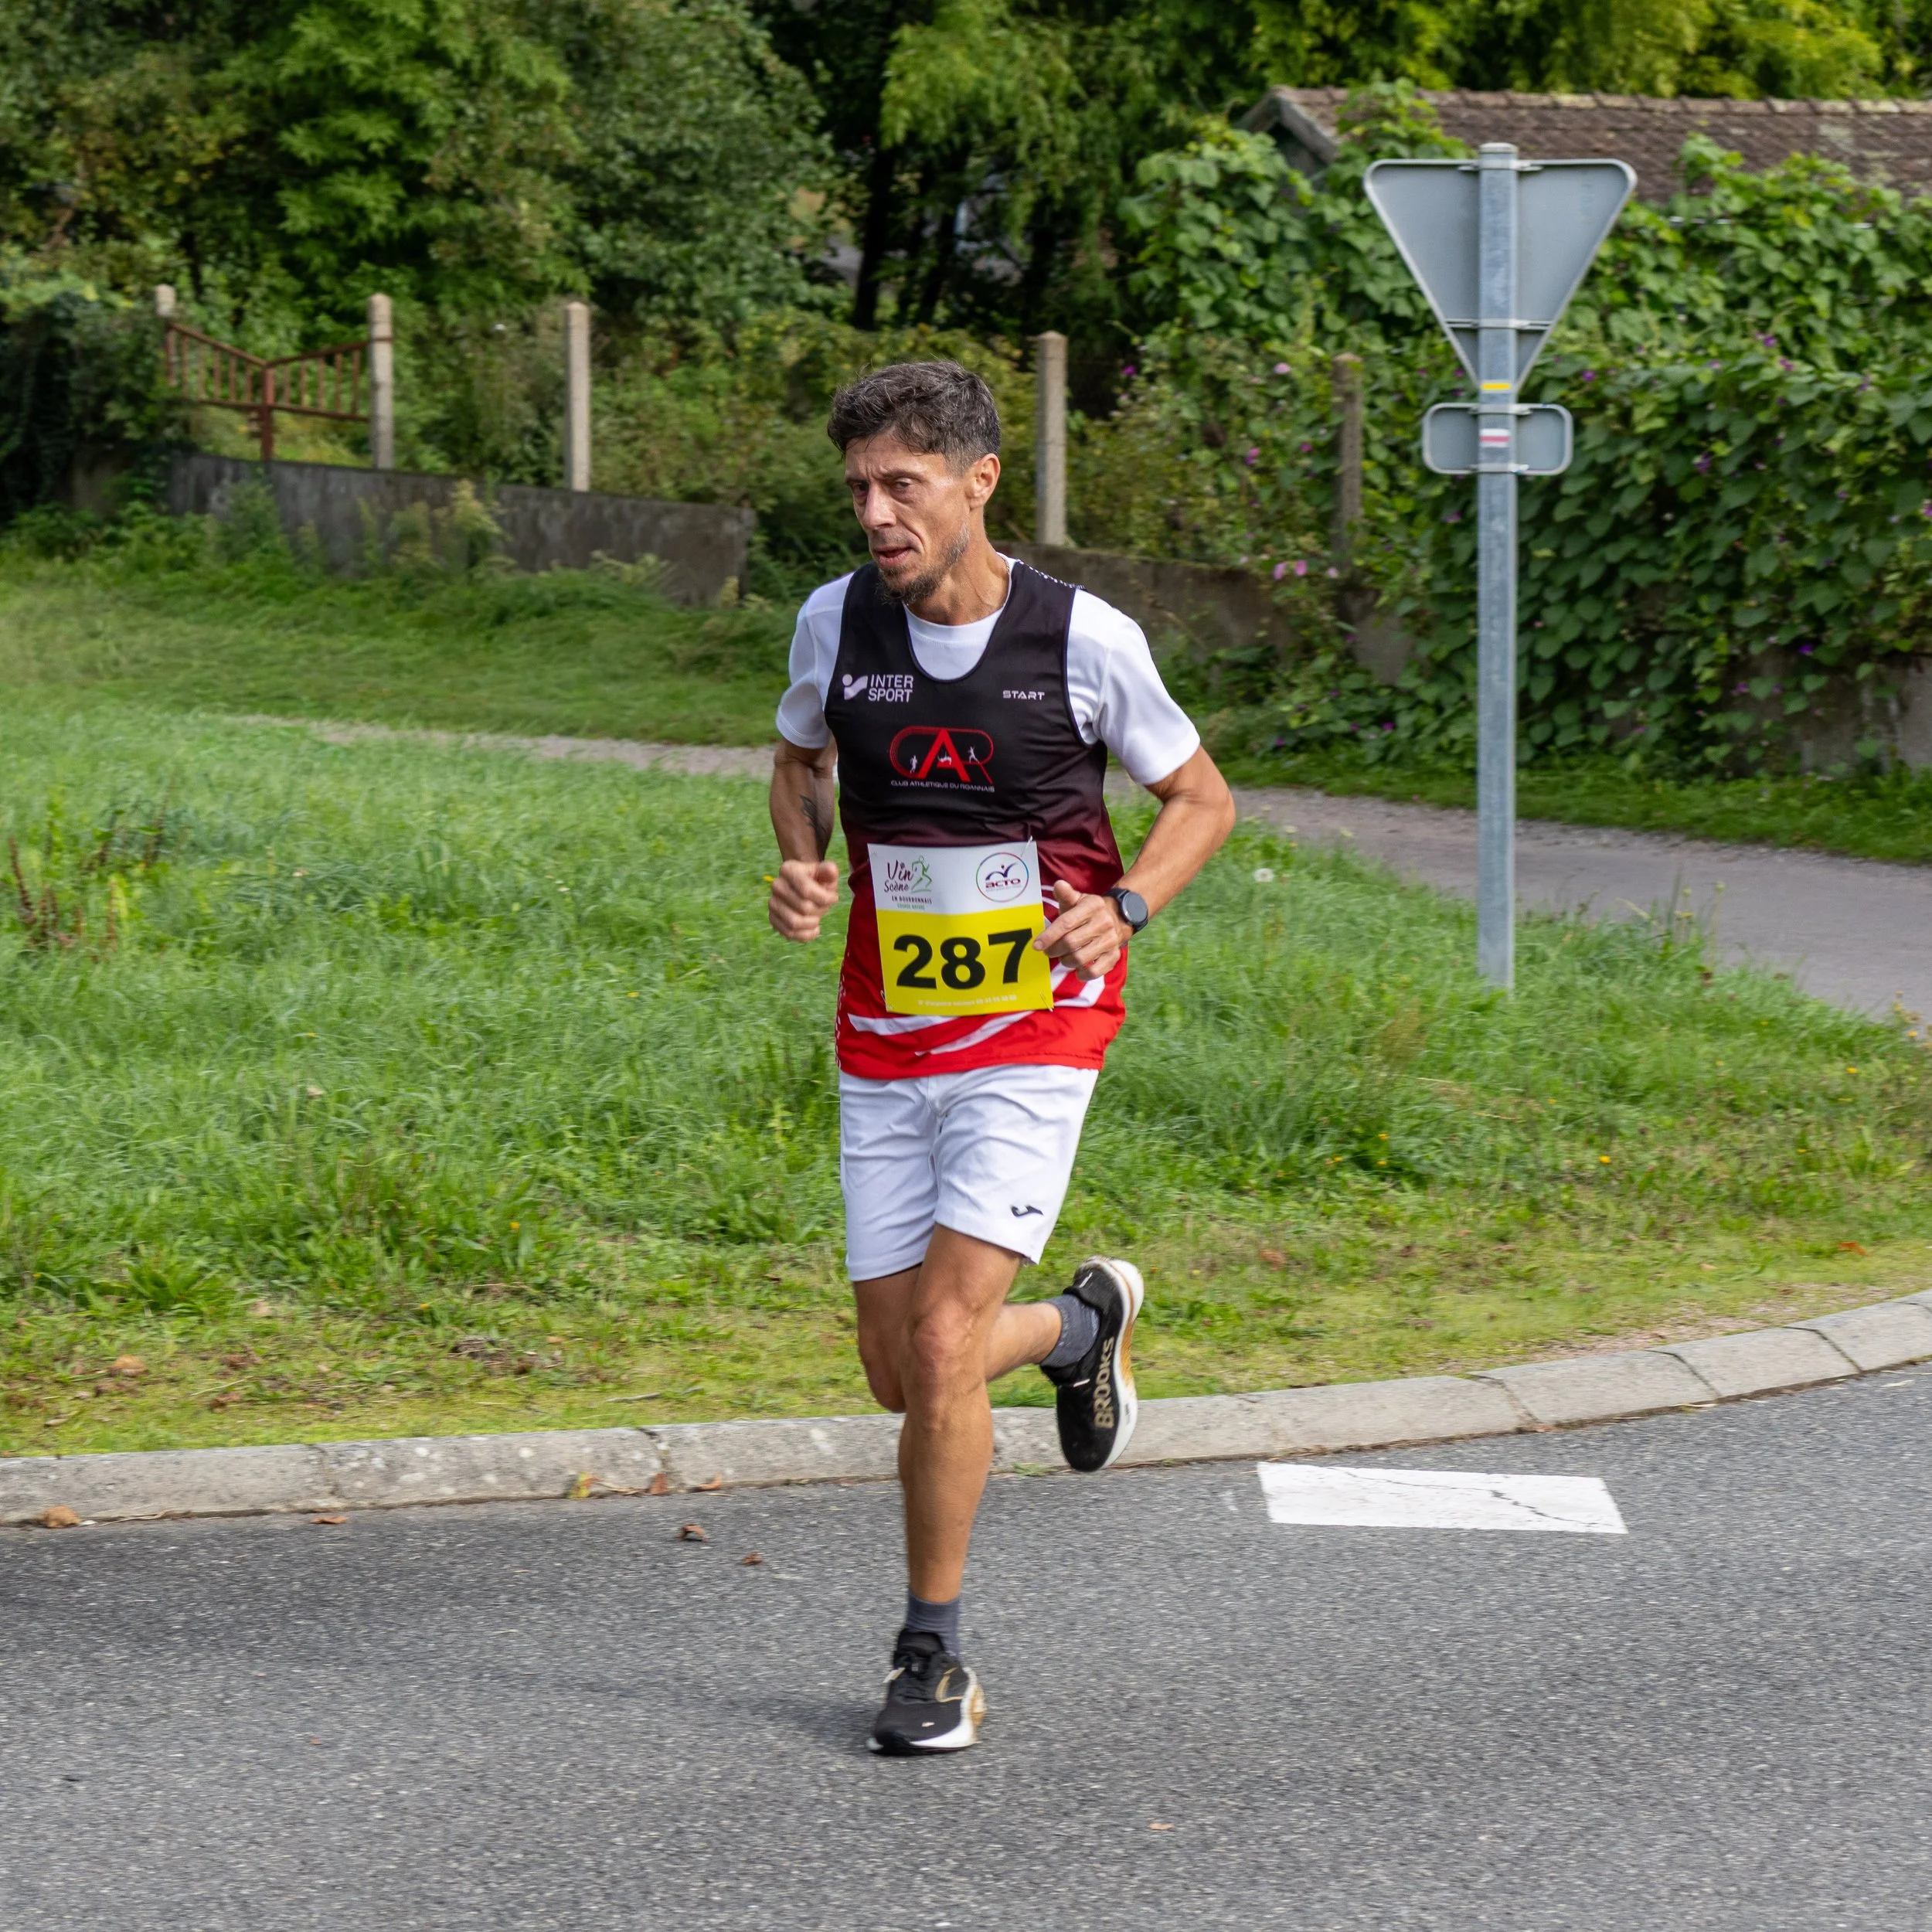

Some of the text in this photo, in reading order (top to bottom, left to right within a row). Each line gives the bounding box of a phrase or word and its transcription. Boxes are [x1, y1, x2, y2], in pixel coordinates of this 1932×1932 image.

[869, 674, 914, 689] INTER
[868, 689, 913, 702] SPORT
[1002, 690, 1045, 701] START
[893, 927, 1033, 990] 287
[1094, 1336, 1115, 1430] BROOKS
